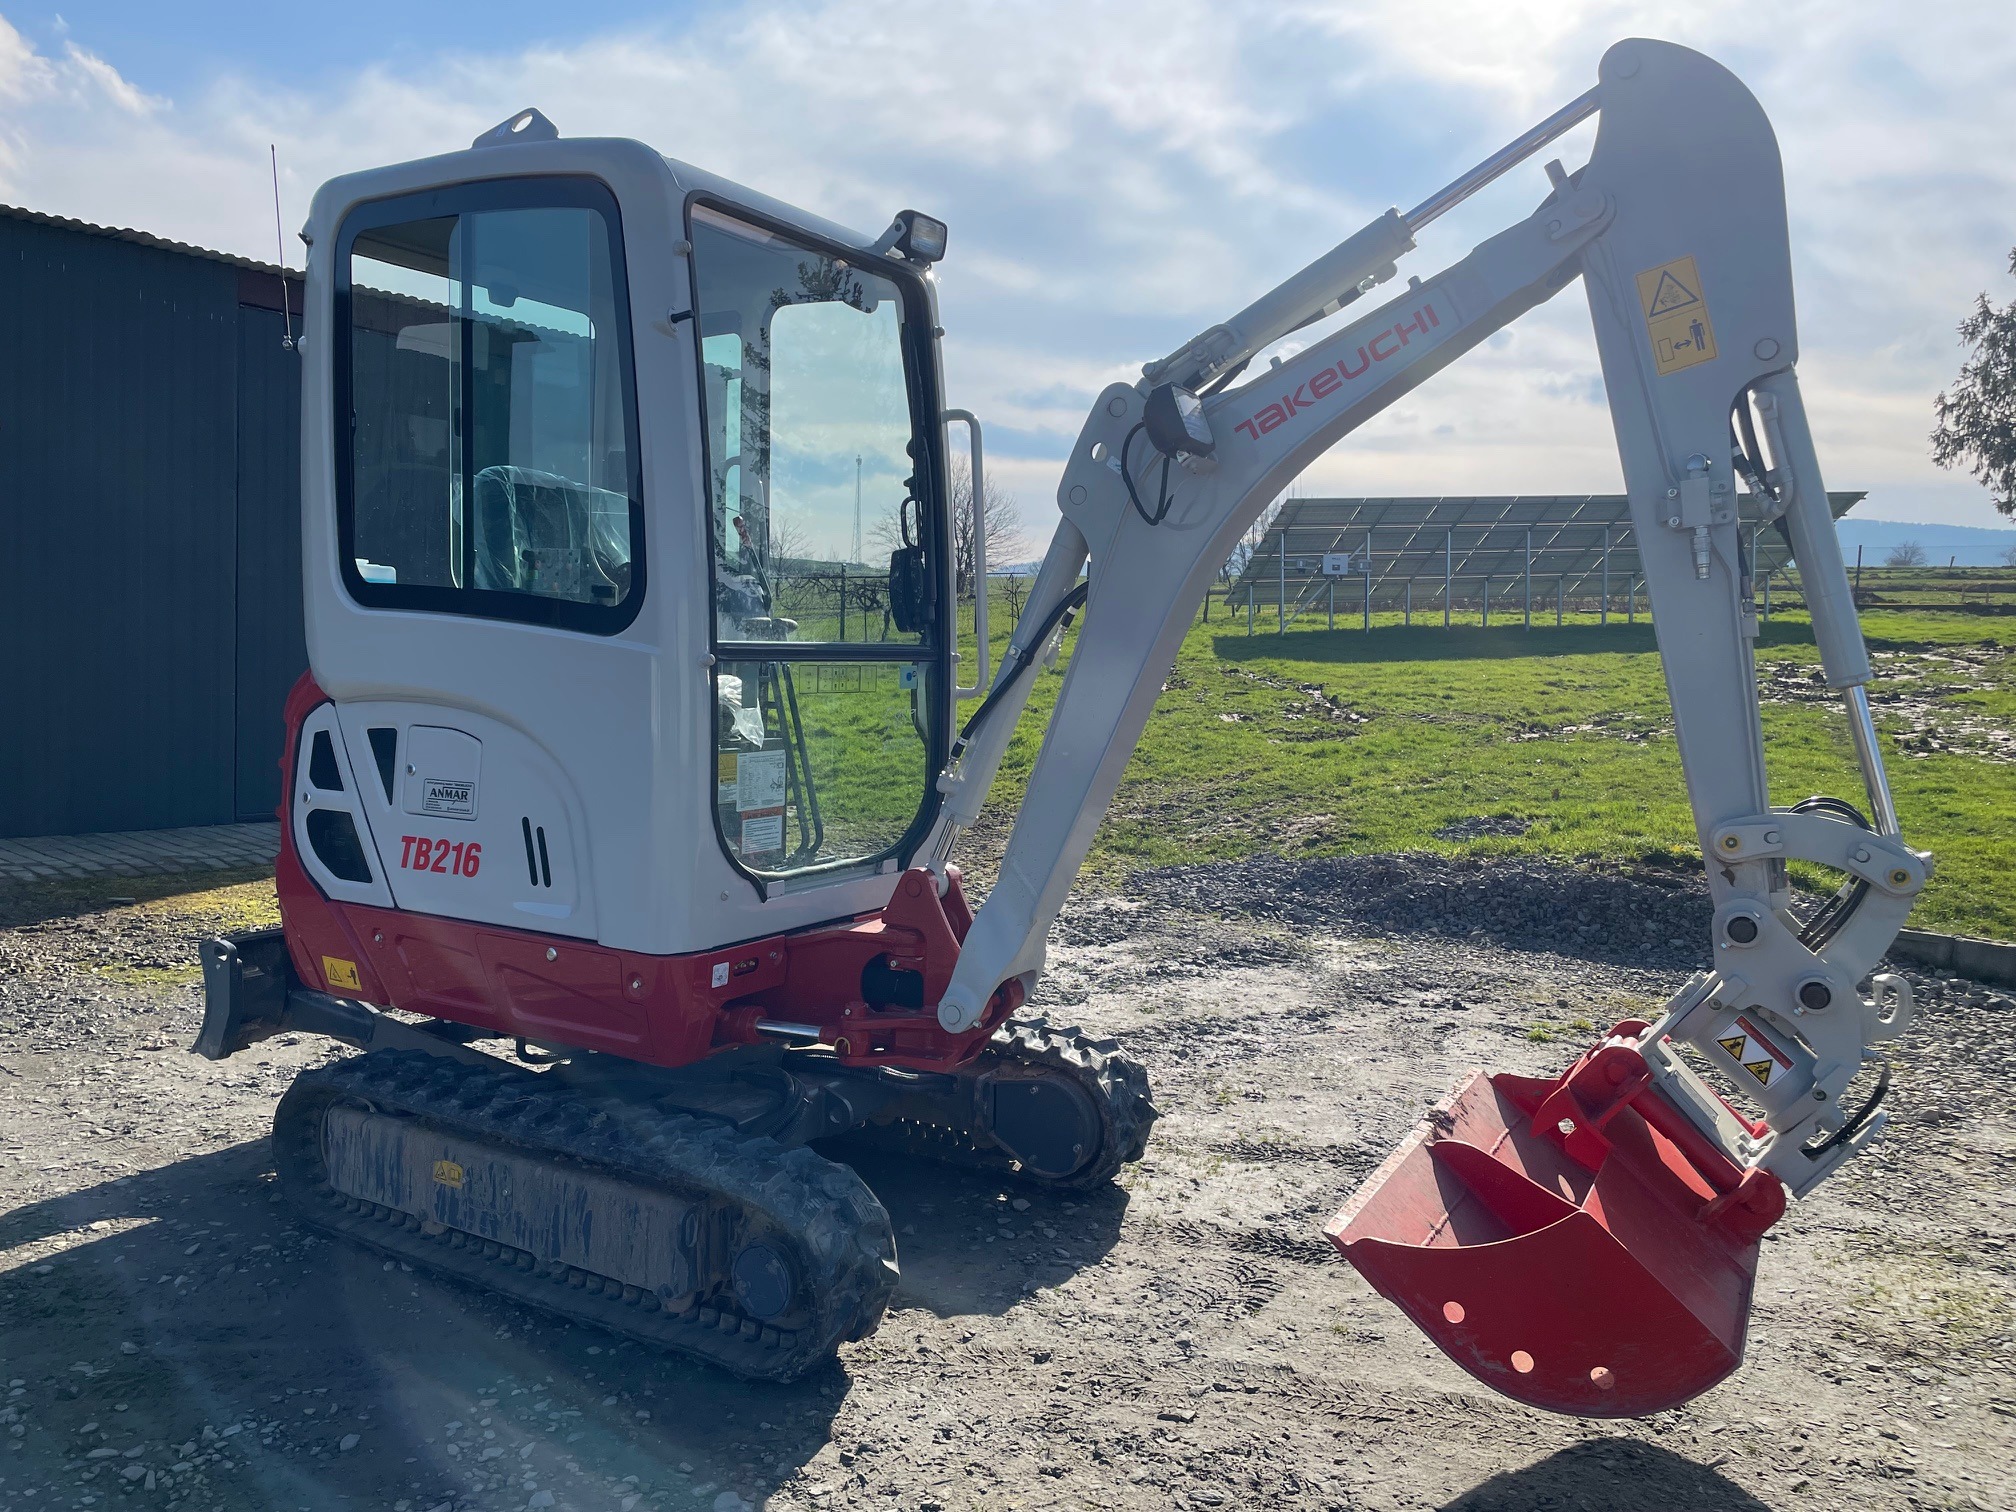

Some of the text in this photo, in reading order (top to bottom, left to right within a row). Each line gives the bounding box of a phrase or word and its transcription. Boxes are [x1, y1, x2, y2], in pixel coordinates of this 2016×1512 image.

[1234, 303, 1440, 440] TAKEUCHI
[430, 787, 469, 801] ANMAR
[401, 835, 482, 877] TB216
